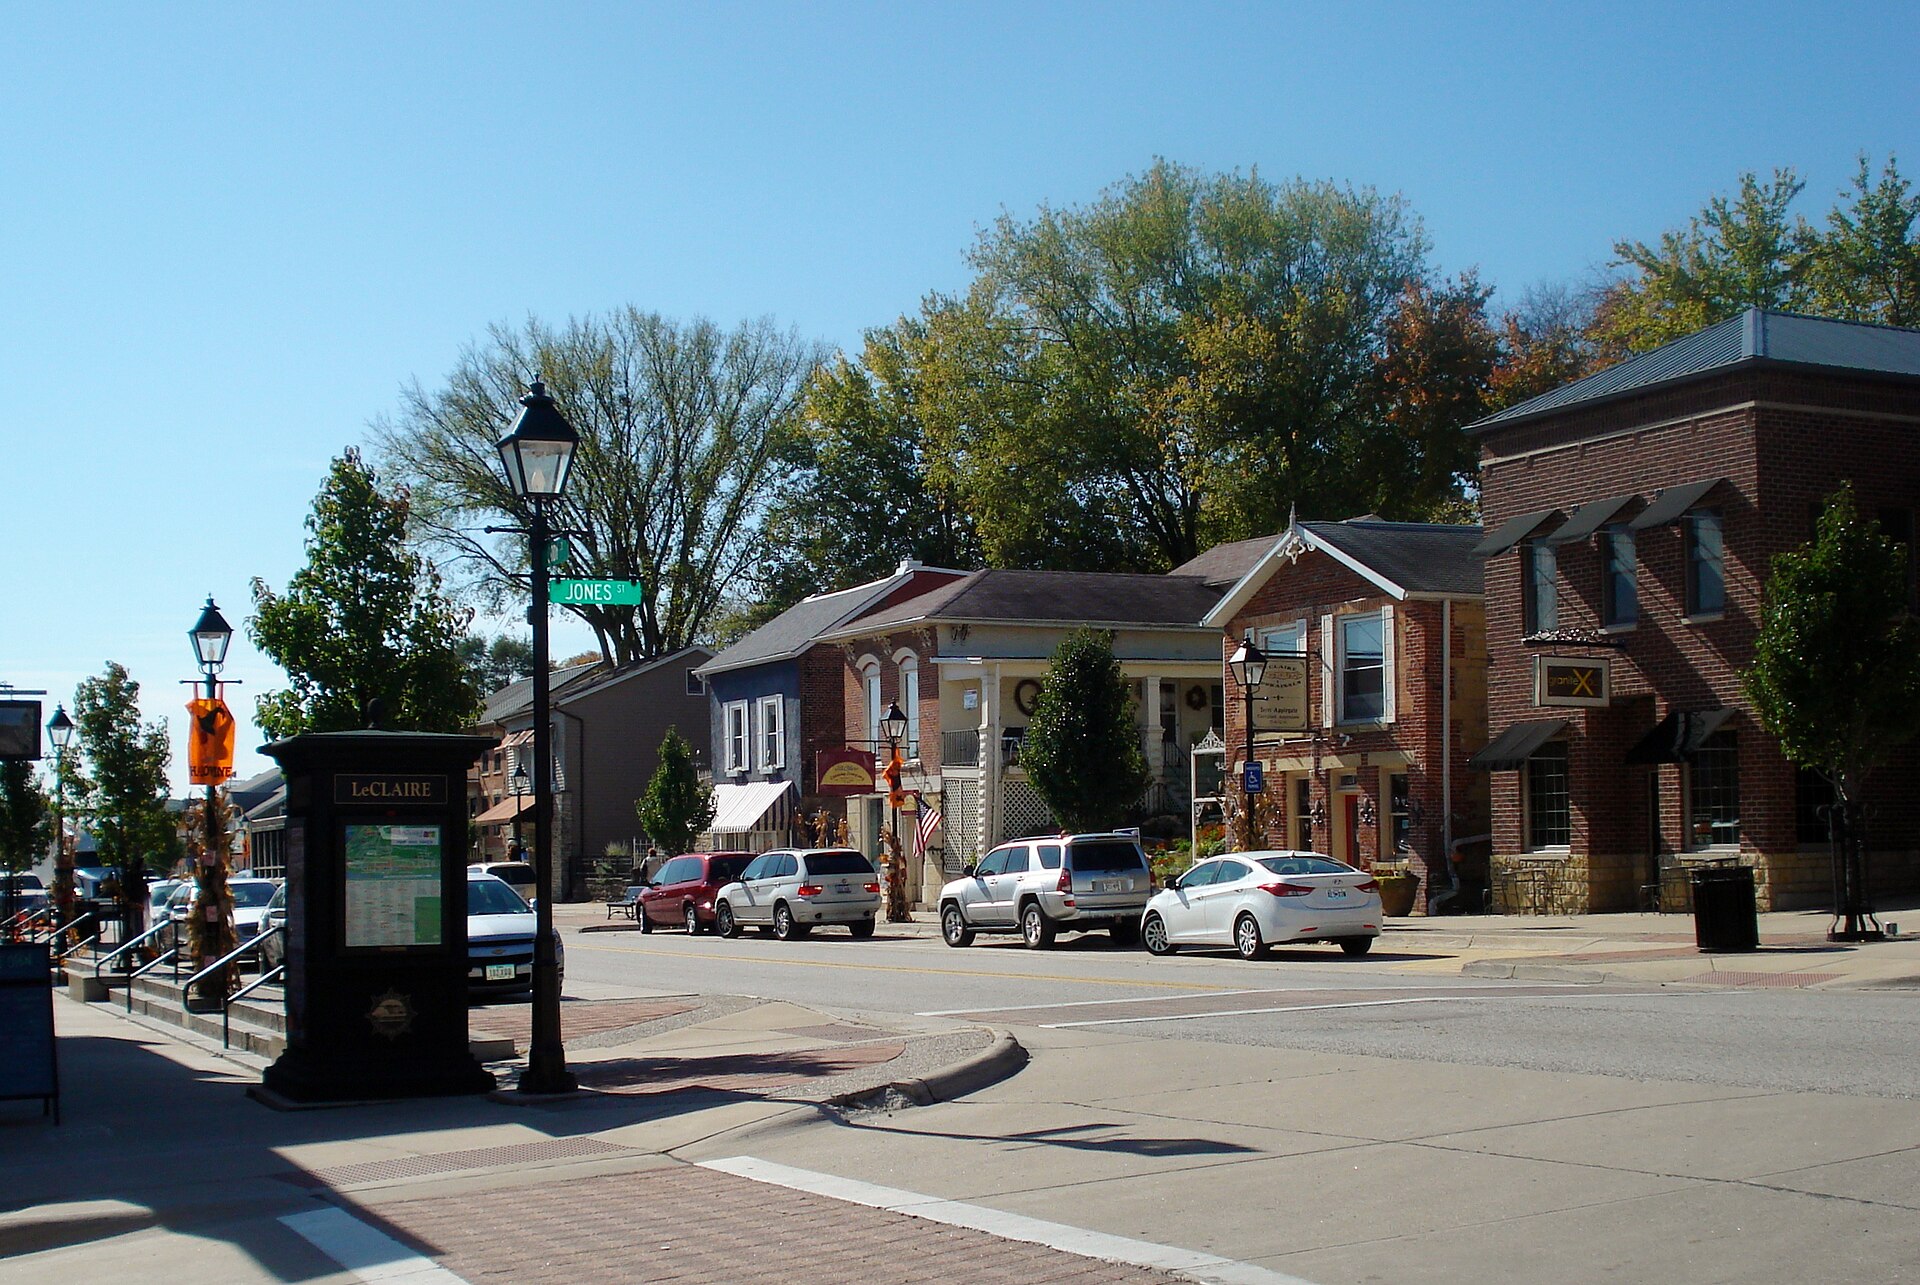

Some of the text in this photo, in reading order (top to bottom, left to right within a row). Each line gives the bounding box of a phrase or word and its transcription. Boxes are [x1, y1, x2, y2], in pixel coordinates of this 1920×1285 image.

[565, 583, 625, 600] JONES ST
[351, 781, 431, 797] LeCLAIRE
